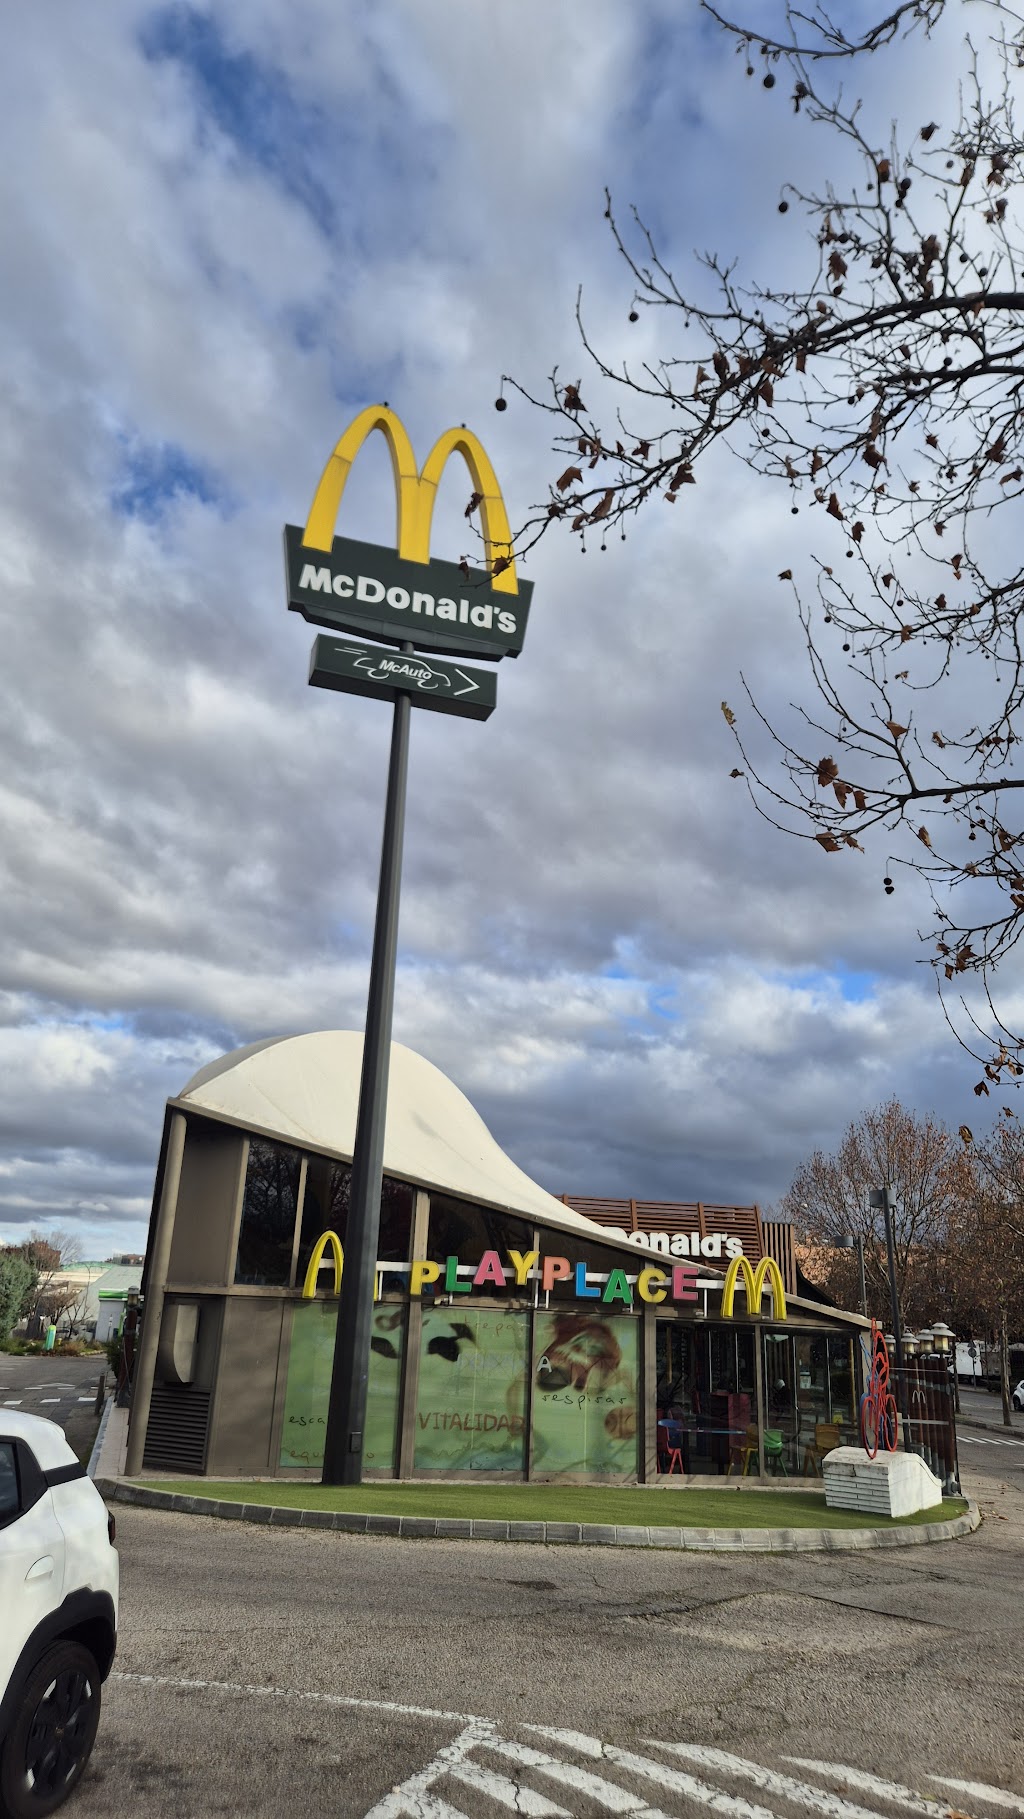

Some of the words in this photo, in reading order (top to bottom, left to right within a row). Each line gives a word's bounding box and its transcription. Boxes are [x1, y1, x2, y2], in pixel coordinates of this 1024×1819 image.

[299, 563, 518, 634] McDonald's
[378, 659, 433, 681] McAuto
[541, 1392, 627, 1410] respirar
[288, 1415, 326, 1426] esca
